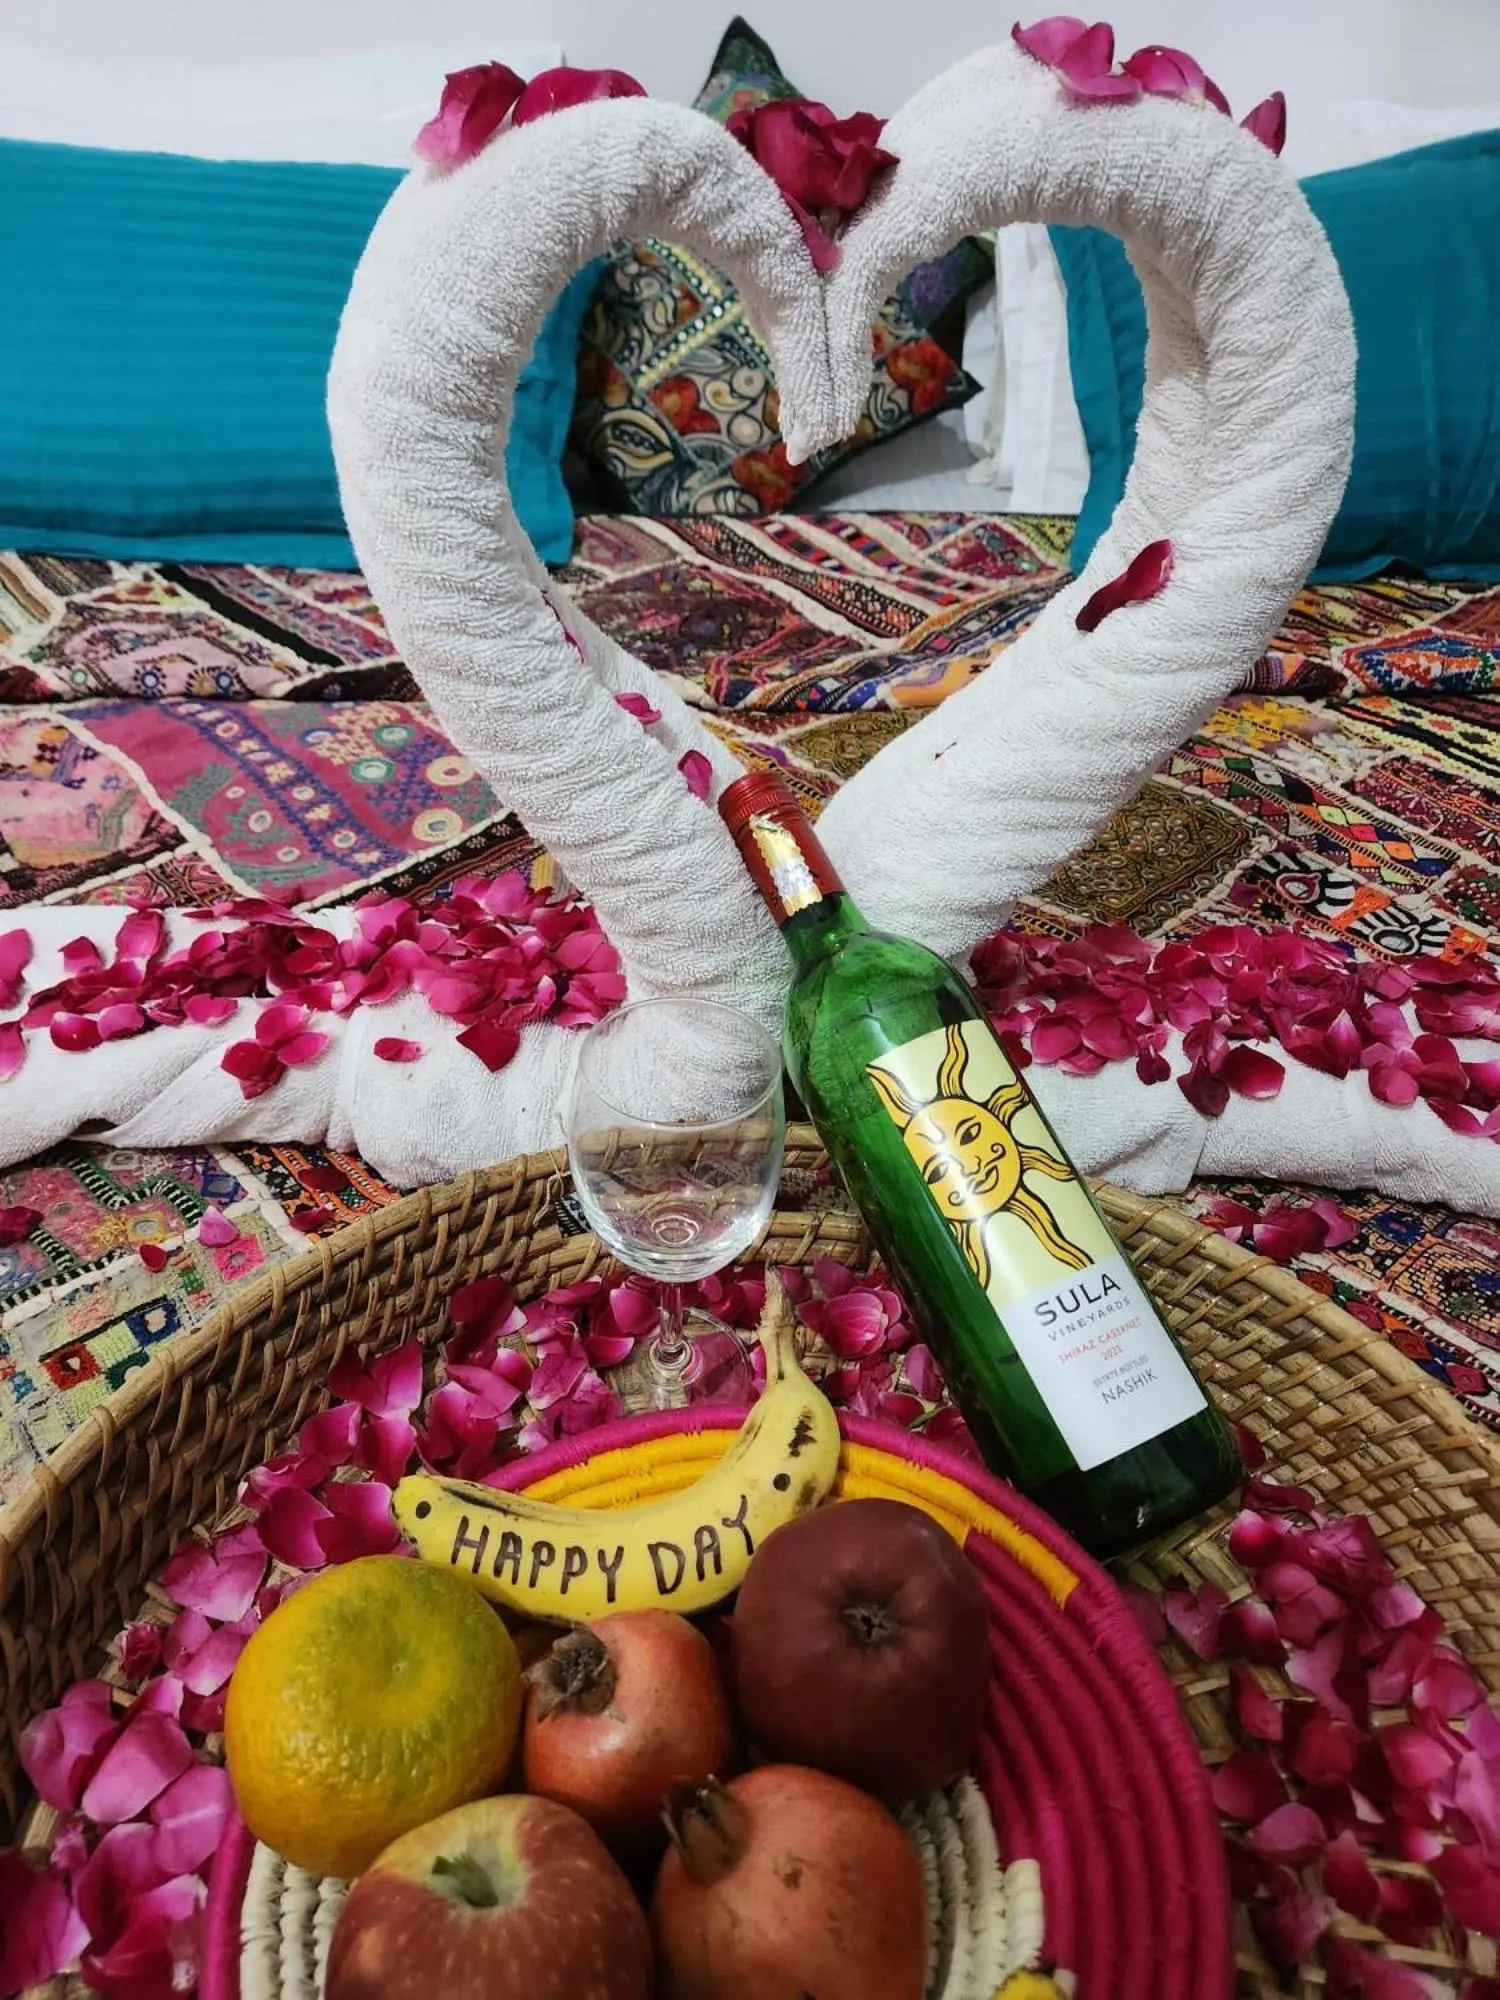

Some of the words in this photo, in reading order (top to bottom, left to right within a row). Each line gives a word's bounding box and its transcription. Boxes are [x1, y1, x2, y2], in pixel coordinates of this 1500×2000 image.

[1034, 1273, 1121, 1326] SULA
[1048, 1296, 1131, 1342] VINEYARDS
[1058, 1341, 1096, 1365] SHIRAZ
[1101, 1368, 1159, 1404] NASHIK
[450, 1515, 624, 1603] HAPPY
[648, 1494, 754, 1595] DAY
